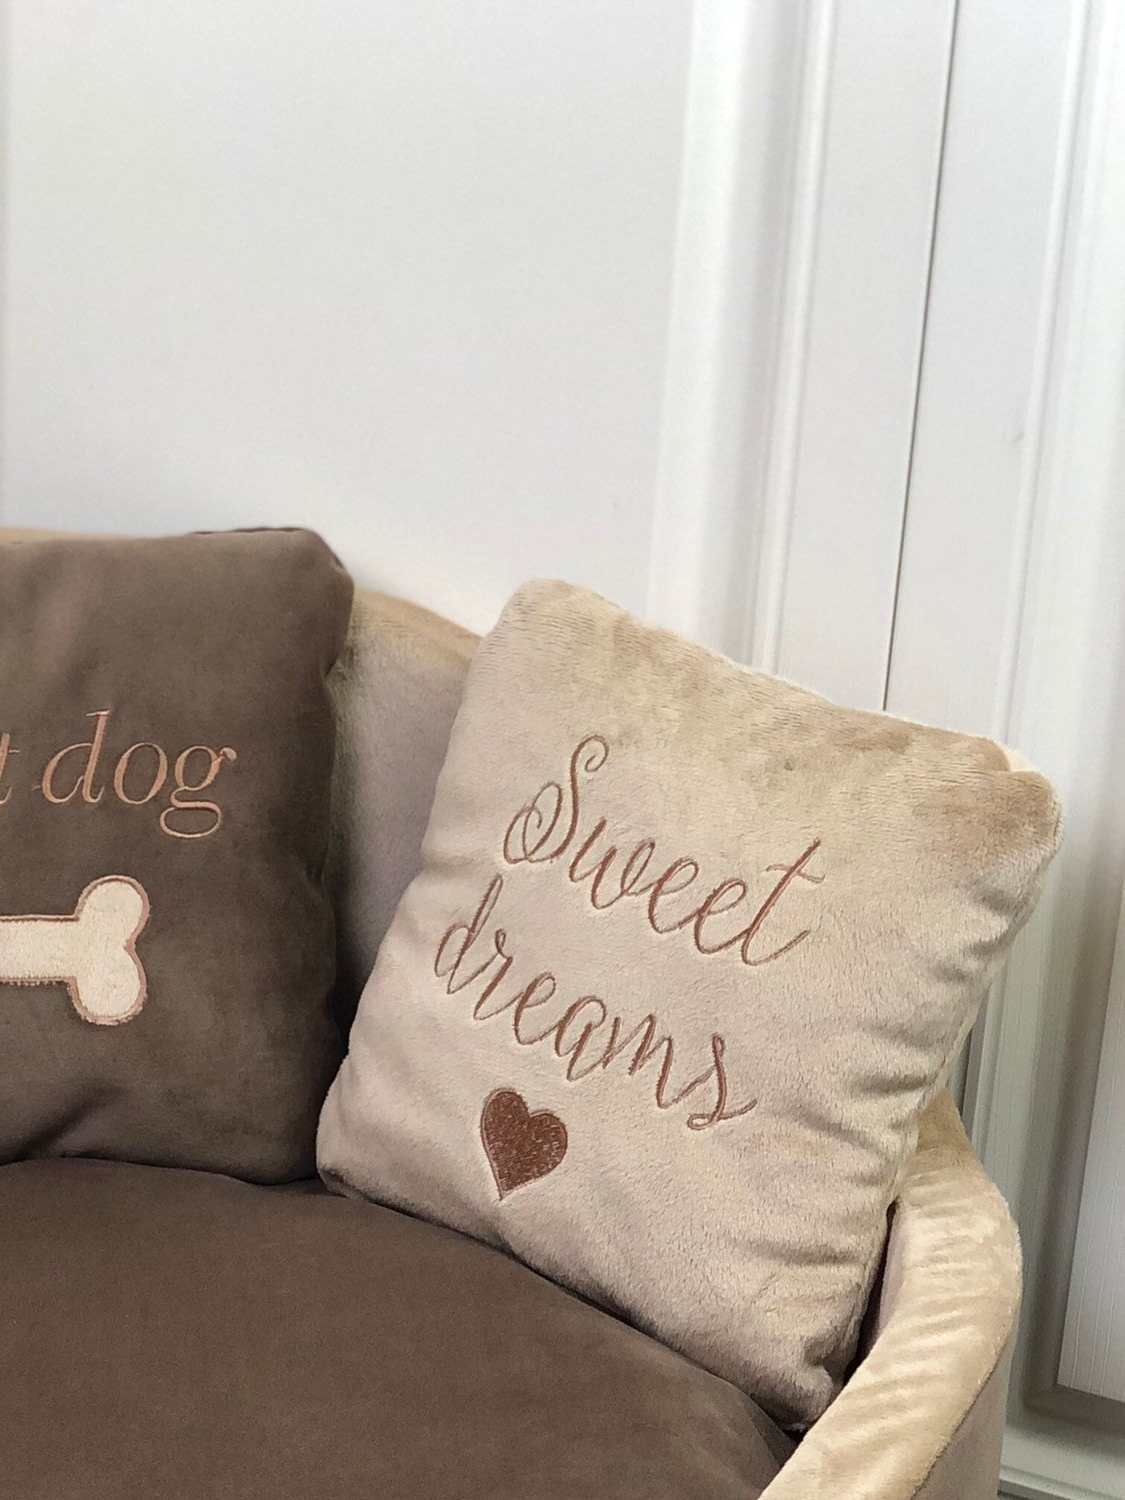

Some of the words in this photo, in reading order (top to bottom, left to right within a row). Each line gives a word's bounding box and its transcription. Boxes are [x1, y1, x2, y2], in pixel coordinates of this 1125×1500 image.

[32, 708, 238, 838] dog
[502, 733, 826, 967] Sweet
[433, 873, 757, 1132] dreams
